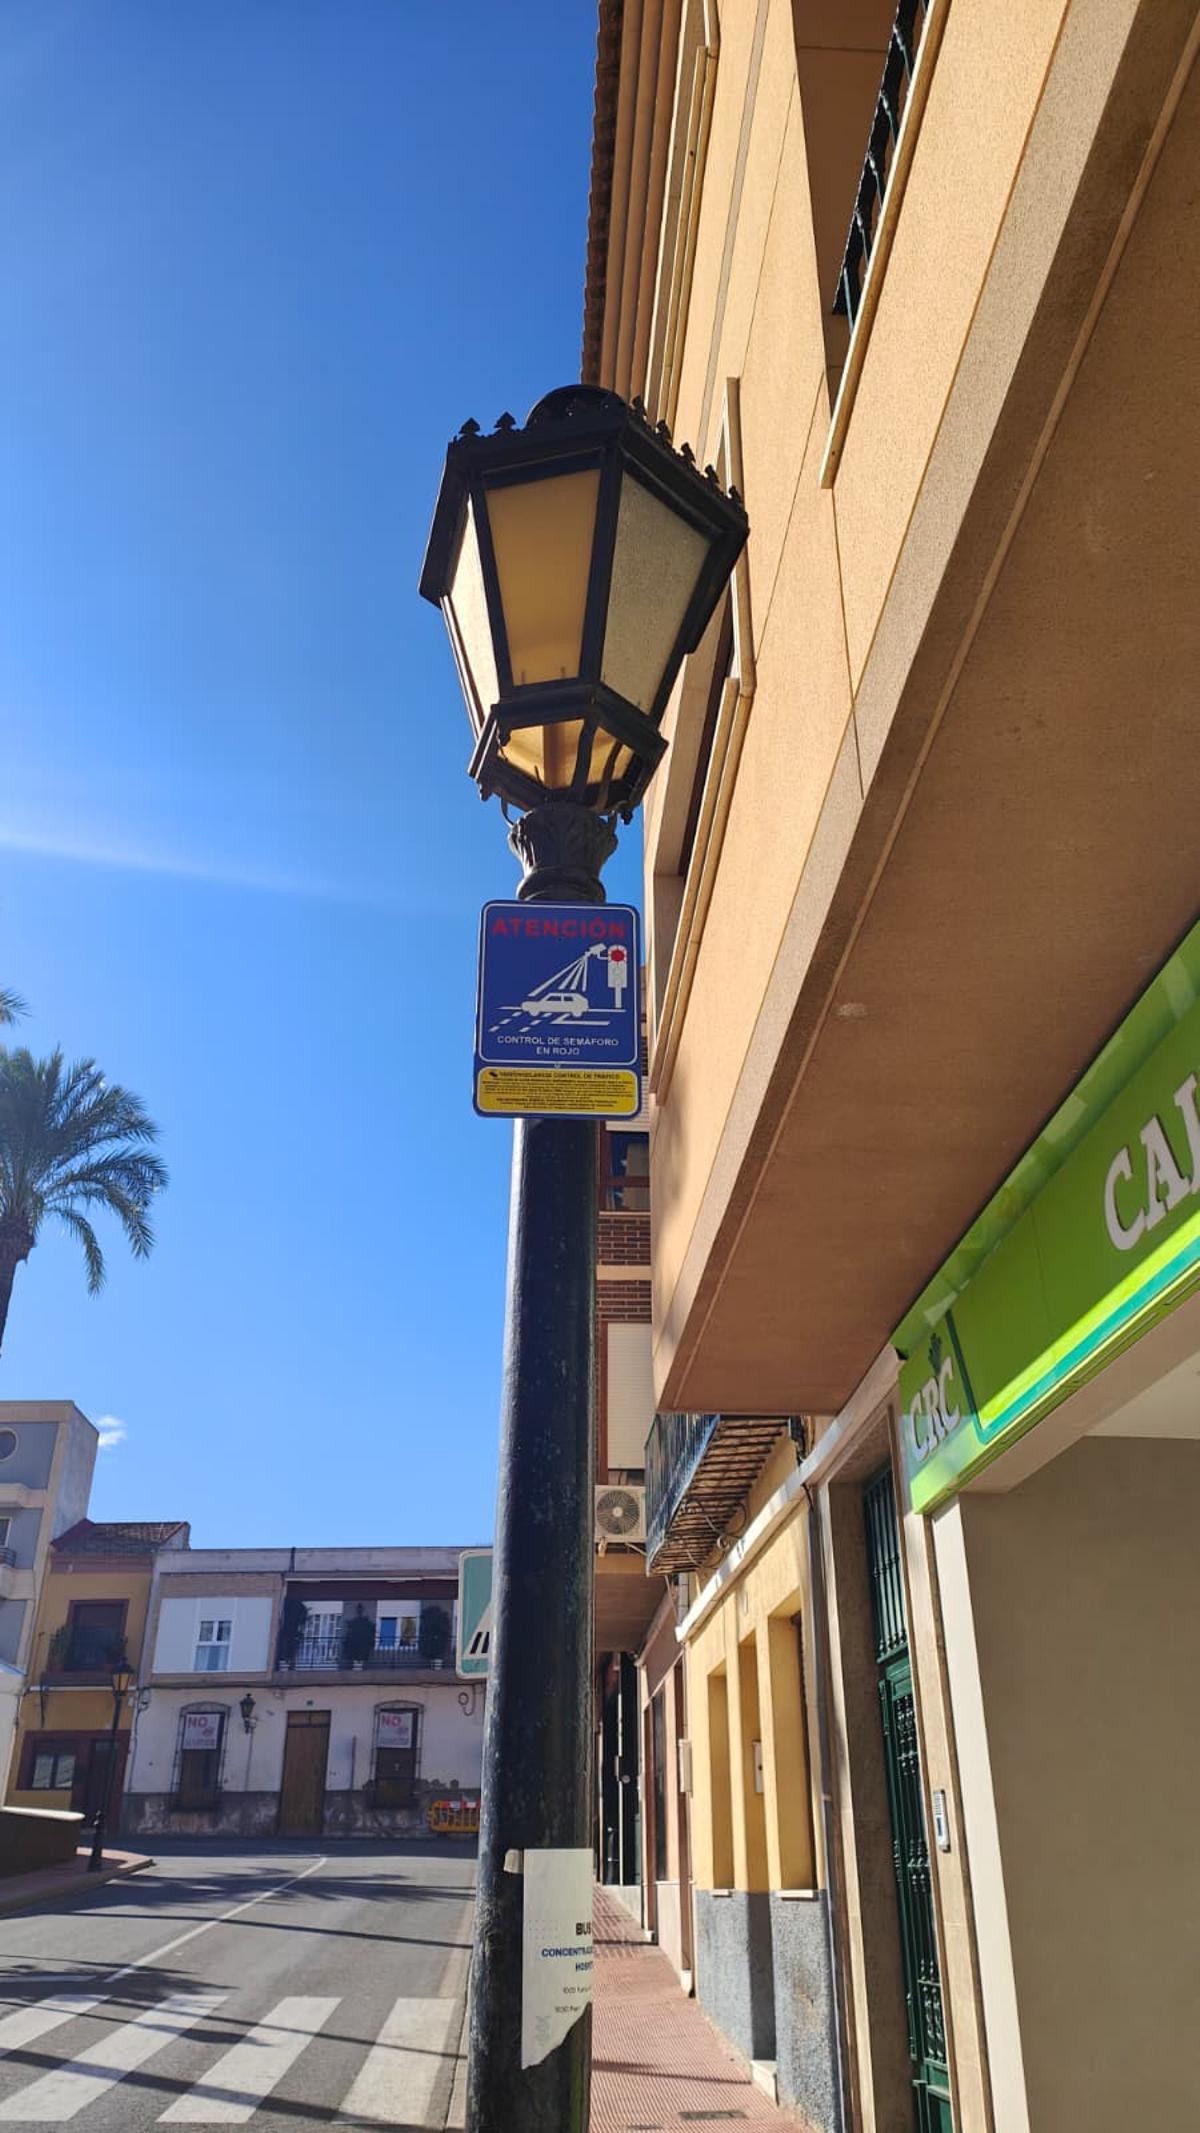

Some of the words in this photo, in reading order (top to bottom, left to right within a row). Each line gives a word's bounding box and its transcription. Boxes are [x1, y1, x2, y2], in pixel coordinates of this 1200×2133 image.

[492, 917, 626, 940] ATENCIÓN
[497, 1035, 545, 1045] CONTROL
[548, 1037, 560, 1045] DE
[537, 1047, 550, 1055] EN
[553, 1047, 580, 1056] ROJO
[909, 1356, 961, 1462] CRC
[188, 1716, 208, 1729] NO
[382, 1715, 402, 1728] NO
